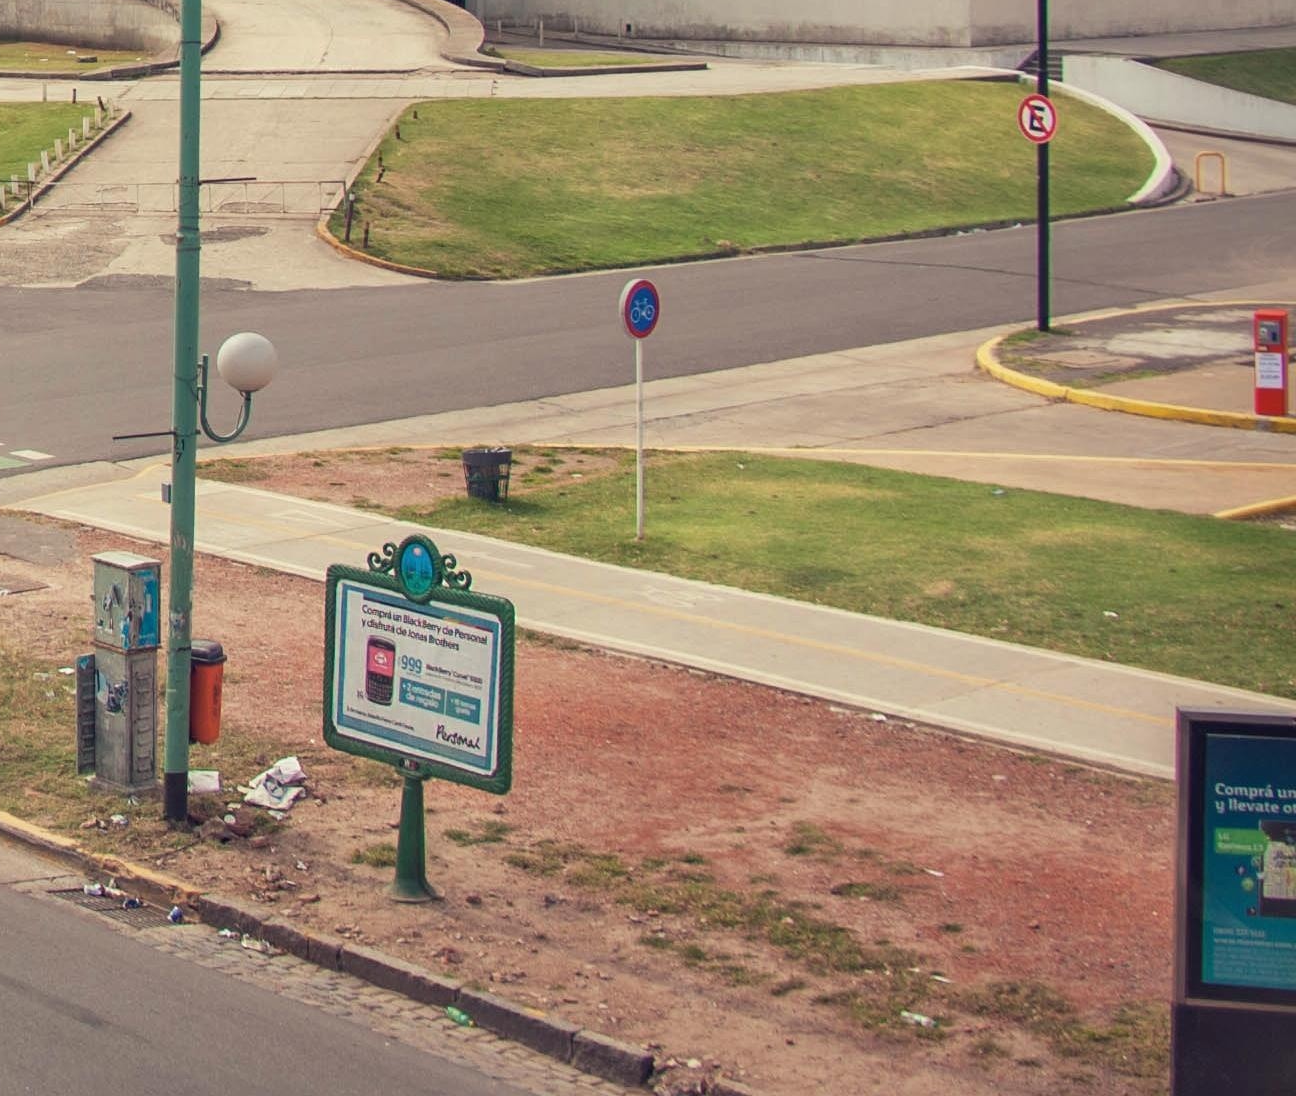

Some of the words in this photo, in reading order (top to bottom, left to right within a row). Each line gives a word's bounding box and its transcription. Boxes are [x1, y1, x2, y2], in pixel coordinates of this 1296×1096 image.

[361, 619, 366, 627] y
[396, 625, 407, 636] de
[408, 629, 427, 642] Jonas
[428, 634, 460, 651] Brothers
[442, 625, 454, 636] de
[455, 629, 487, 644] Personal
[436, 724, 480, 750] Personal
[1215, 783, 1274, 800] Comprá
[1215, 800, 1225, 814] y
[1229, 798, 1280, 813] llevate
